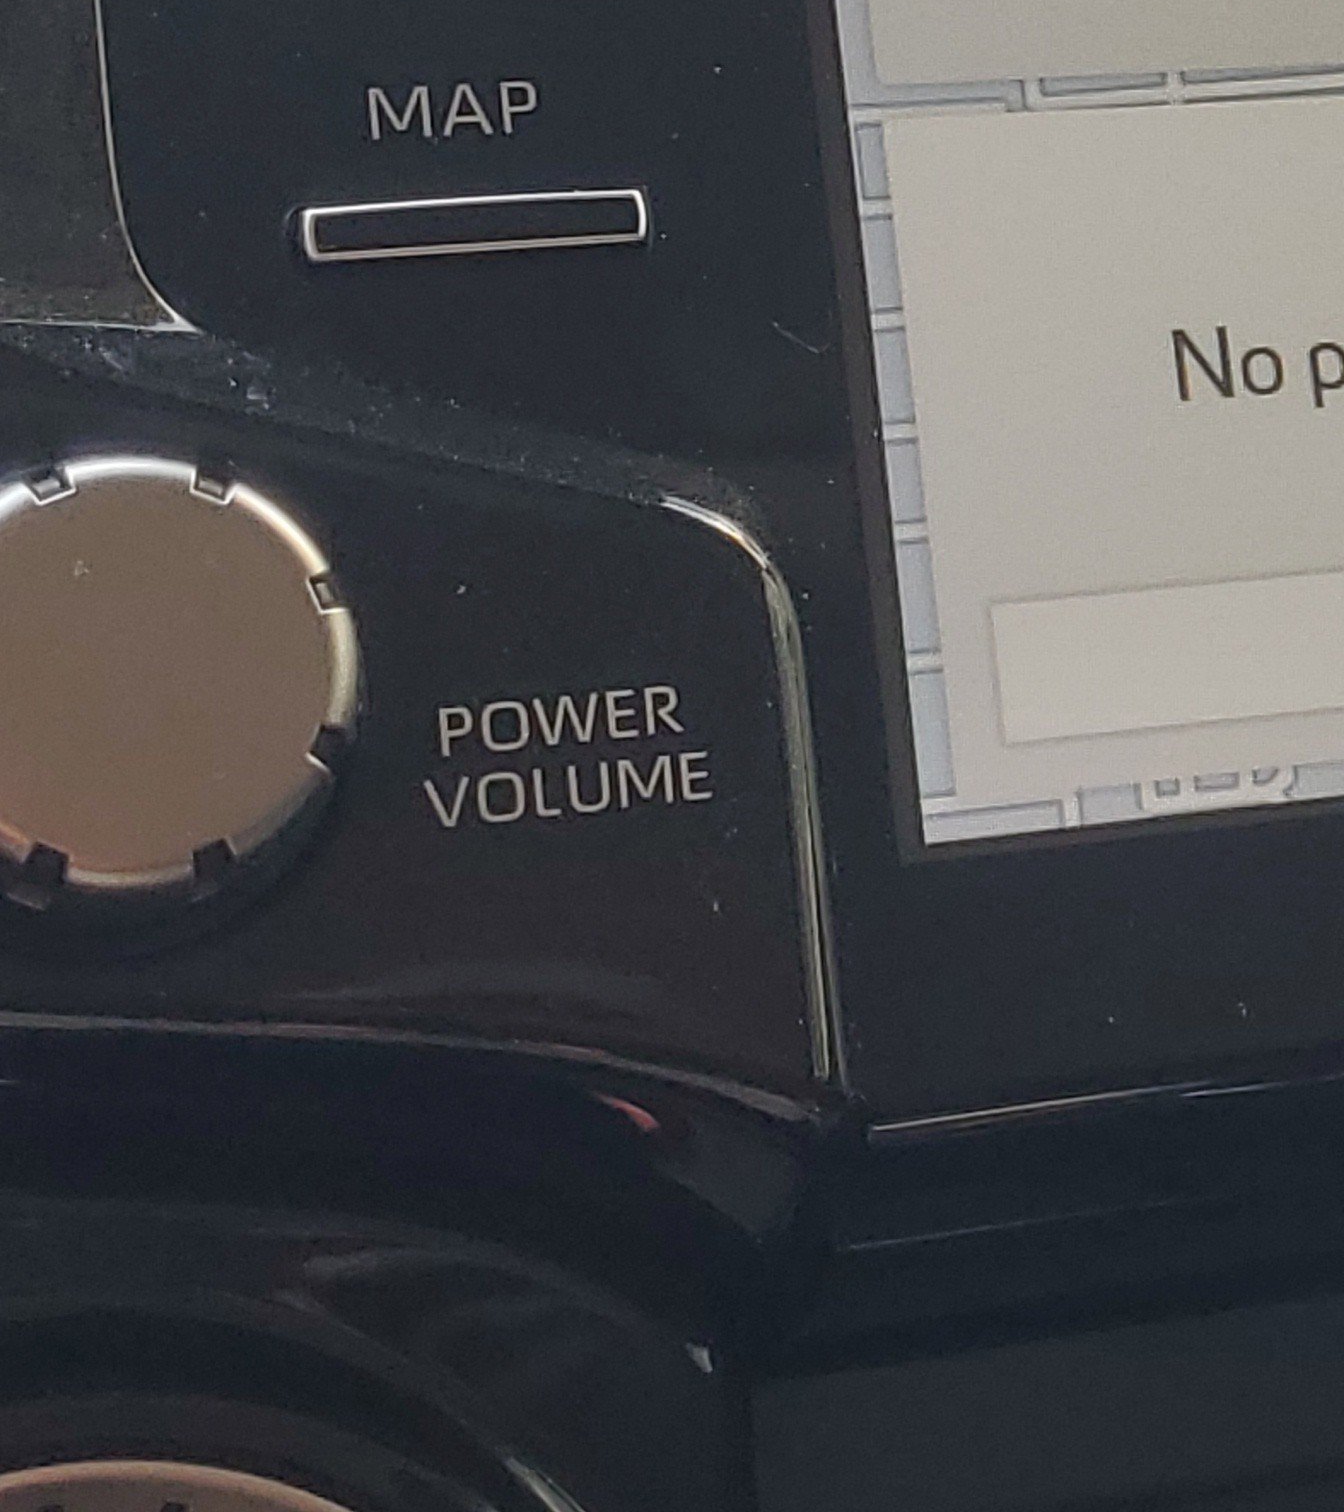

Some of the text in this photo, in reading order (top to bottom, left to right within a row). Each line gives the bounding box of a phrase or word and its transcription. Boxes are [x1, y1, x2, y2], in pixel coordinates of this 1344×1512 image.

[366, 79, 540, 140] MAP
[1170, 324, 1285, 403] No
[437, 684, 685, 758] POWER
[422, 750, 714, 829] VOLUME
